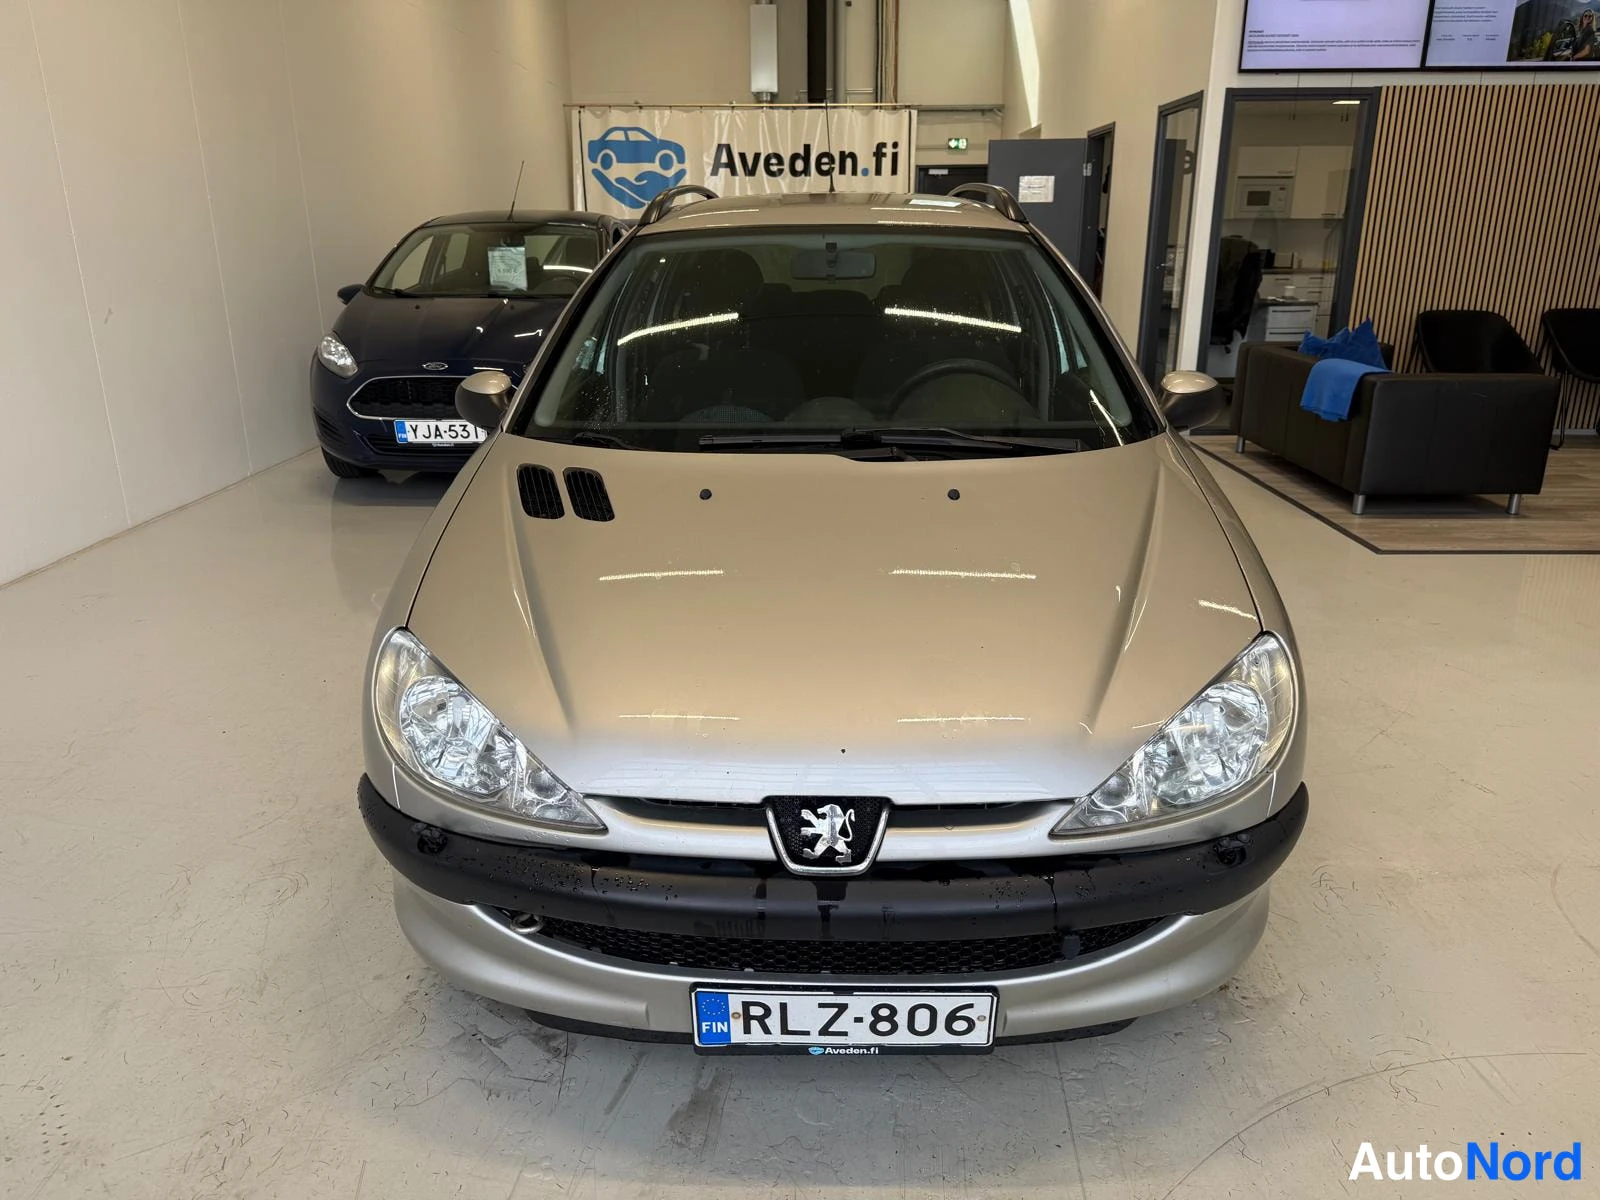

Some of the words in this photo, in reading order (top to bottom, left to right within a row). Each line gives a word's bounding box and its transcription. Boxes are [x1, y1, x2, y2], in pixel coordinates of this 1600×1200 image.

[710, 141, 899, 178] Aveden.fi
[409, 424, 479, 440] YJA-531
[741, 1000, 976, 1037] RLZ-806
[701, 1021, 729, 1034] FIN
[824, 1046, 880, 1055] Aveden.fi
